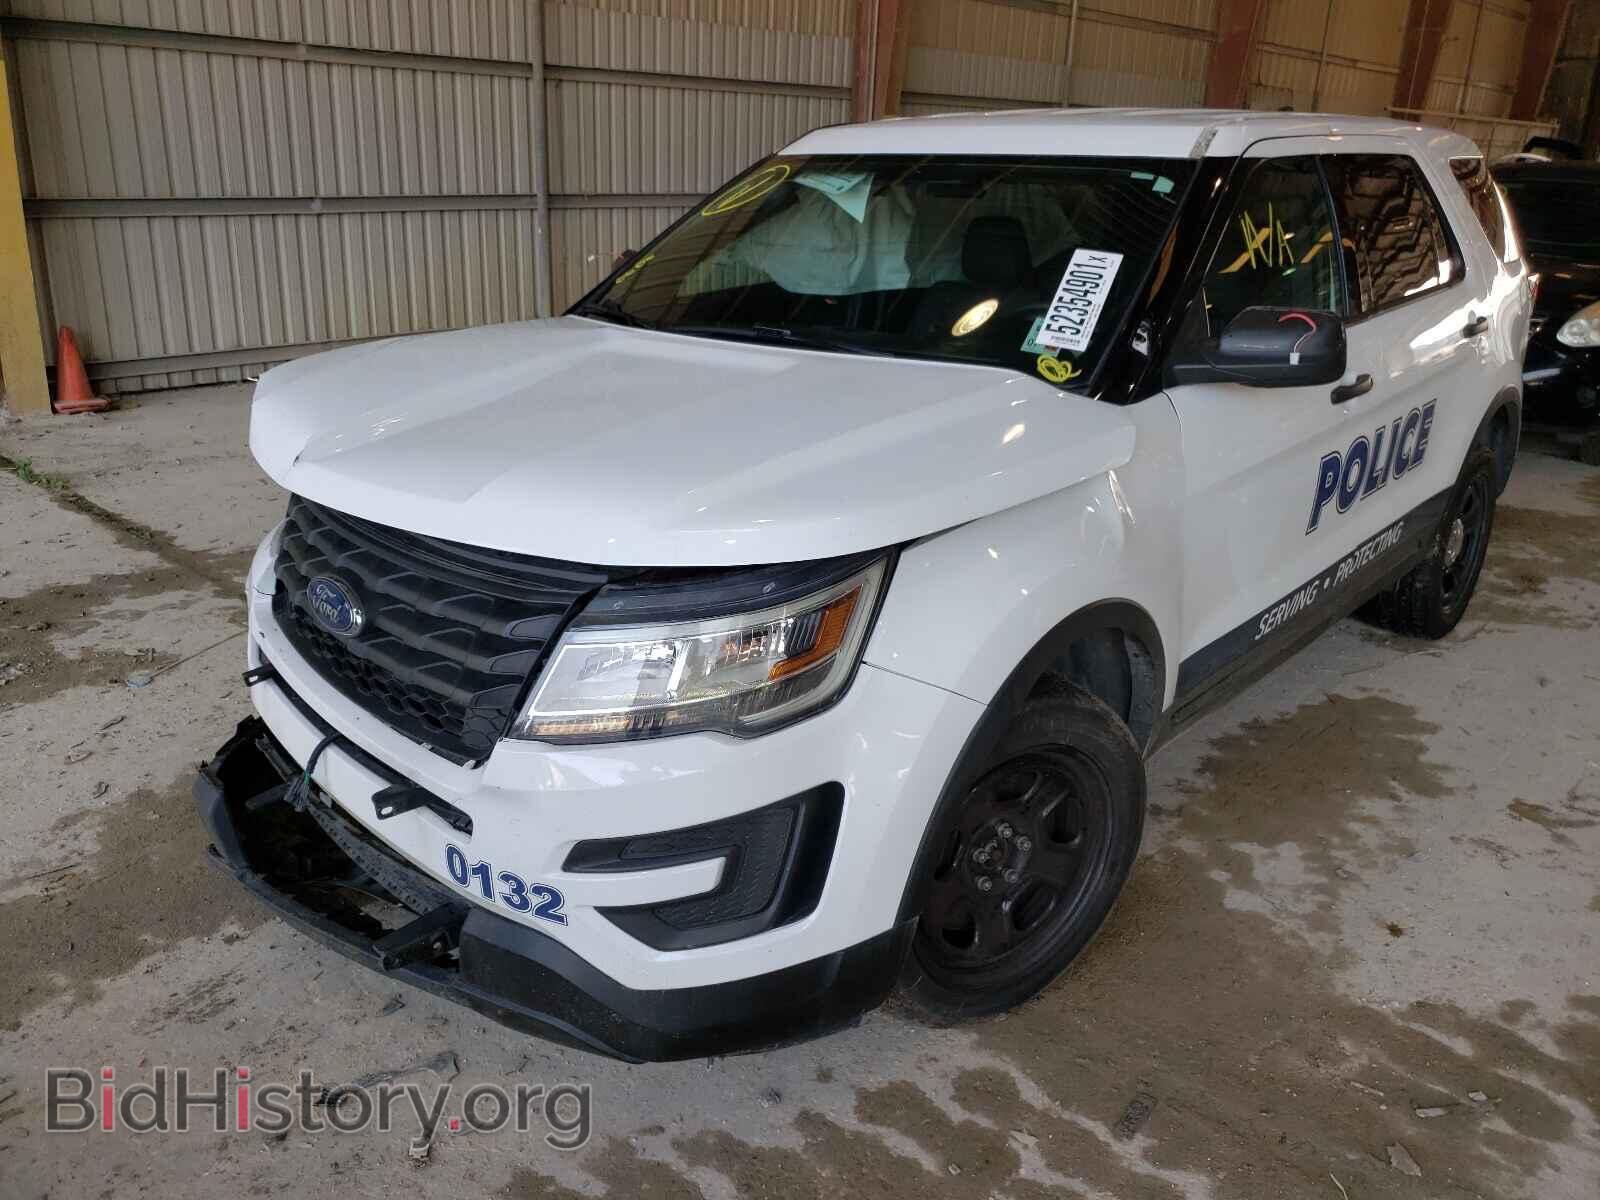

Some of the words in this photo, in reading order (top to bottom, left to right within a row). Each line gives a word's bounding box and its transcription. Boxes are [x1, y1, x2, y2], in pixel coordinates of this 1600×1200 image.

[1045, 262, 1107, 336] 52354901
[1305, 399, 1437, 536] POLICE
[1254, 580, 1319, 640] SERVING
[1332, 521, 1404, 587] PROTECTING
[445, 843, 568, 926] 0132
